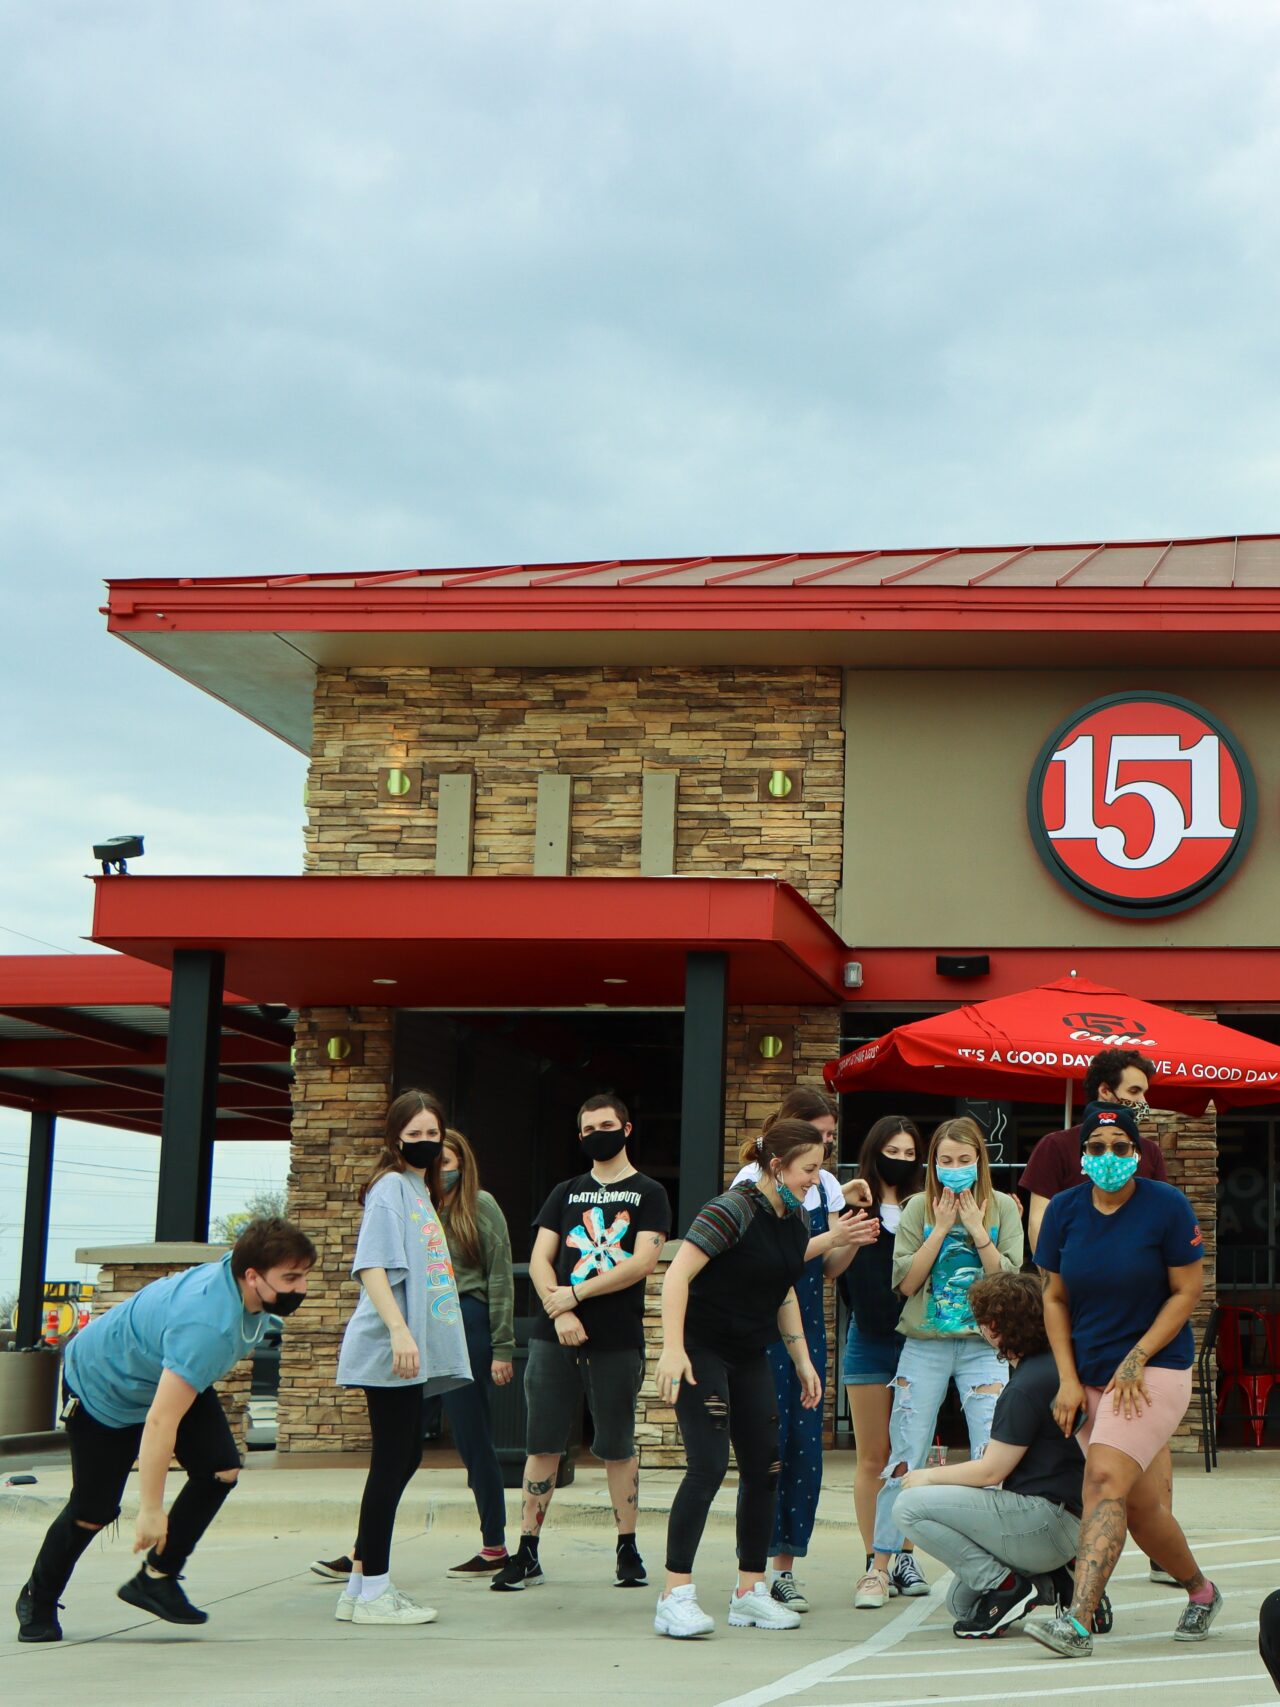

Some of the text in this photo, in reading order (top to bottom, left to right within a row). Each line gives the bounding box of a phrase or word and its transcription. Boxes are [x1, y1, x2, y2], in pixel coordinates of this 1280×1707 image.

[1048, 734, 1238, 870] 151
[1069, 1031, 1158, 1046] Coffee
[990, 1050, 1002, 1062] A
[1006, 1050, 1058, 1066] GOOD
[1062, 1053, 1095, 1067] DAY
[1175, 1062, 1188, 1076] A
[1192, 1063, 1242, 1081] GOOD
[1245, 1069, 1279, 1083] DAY
